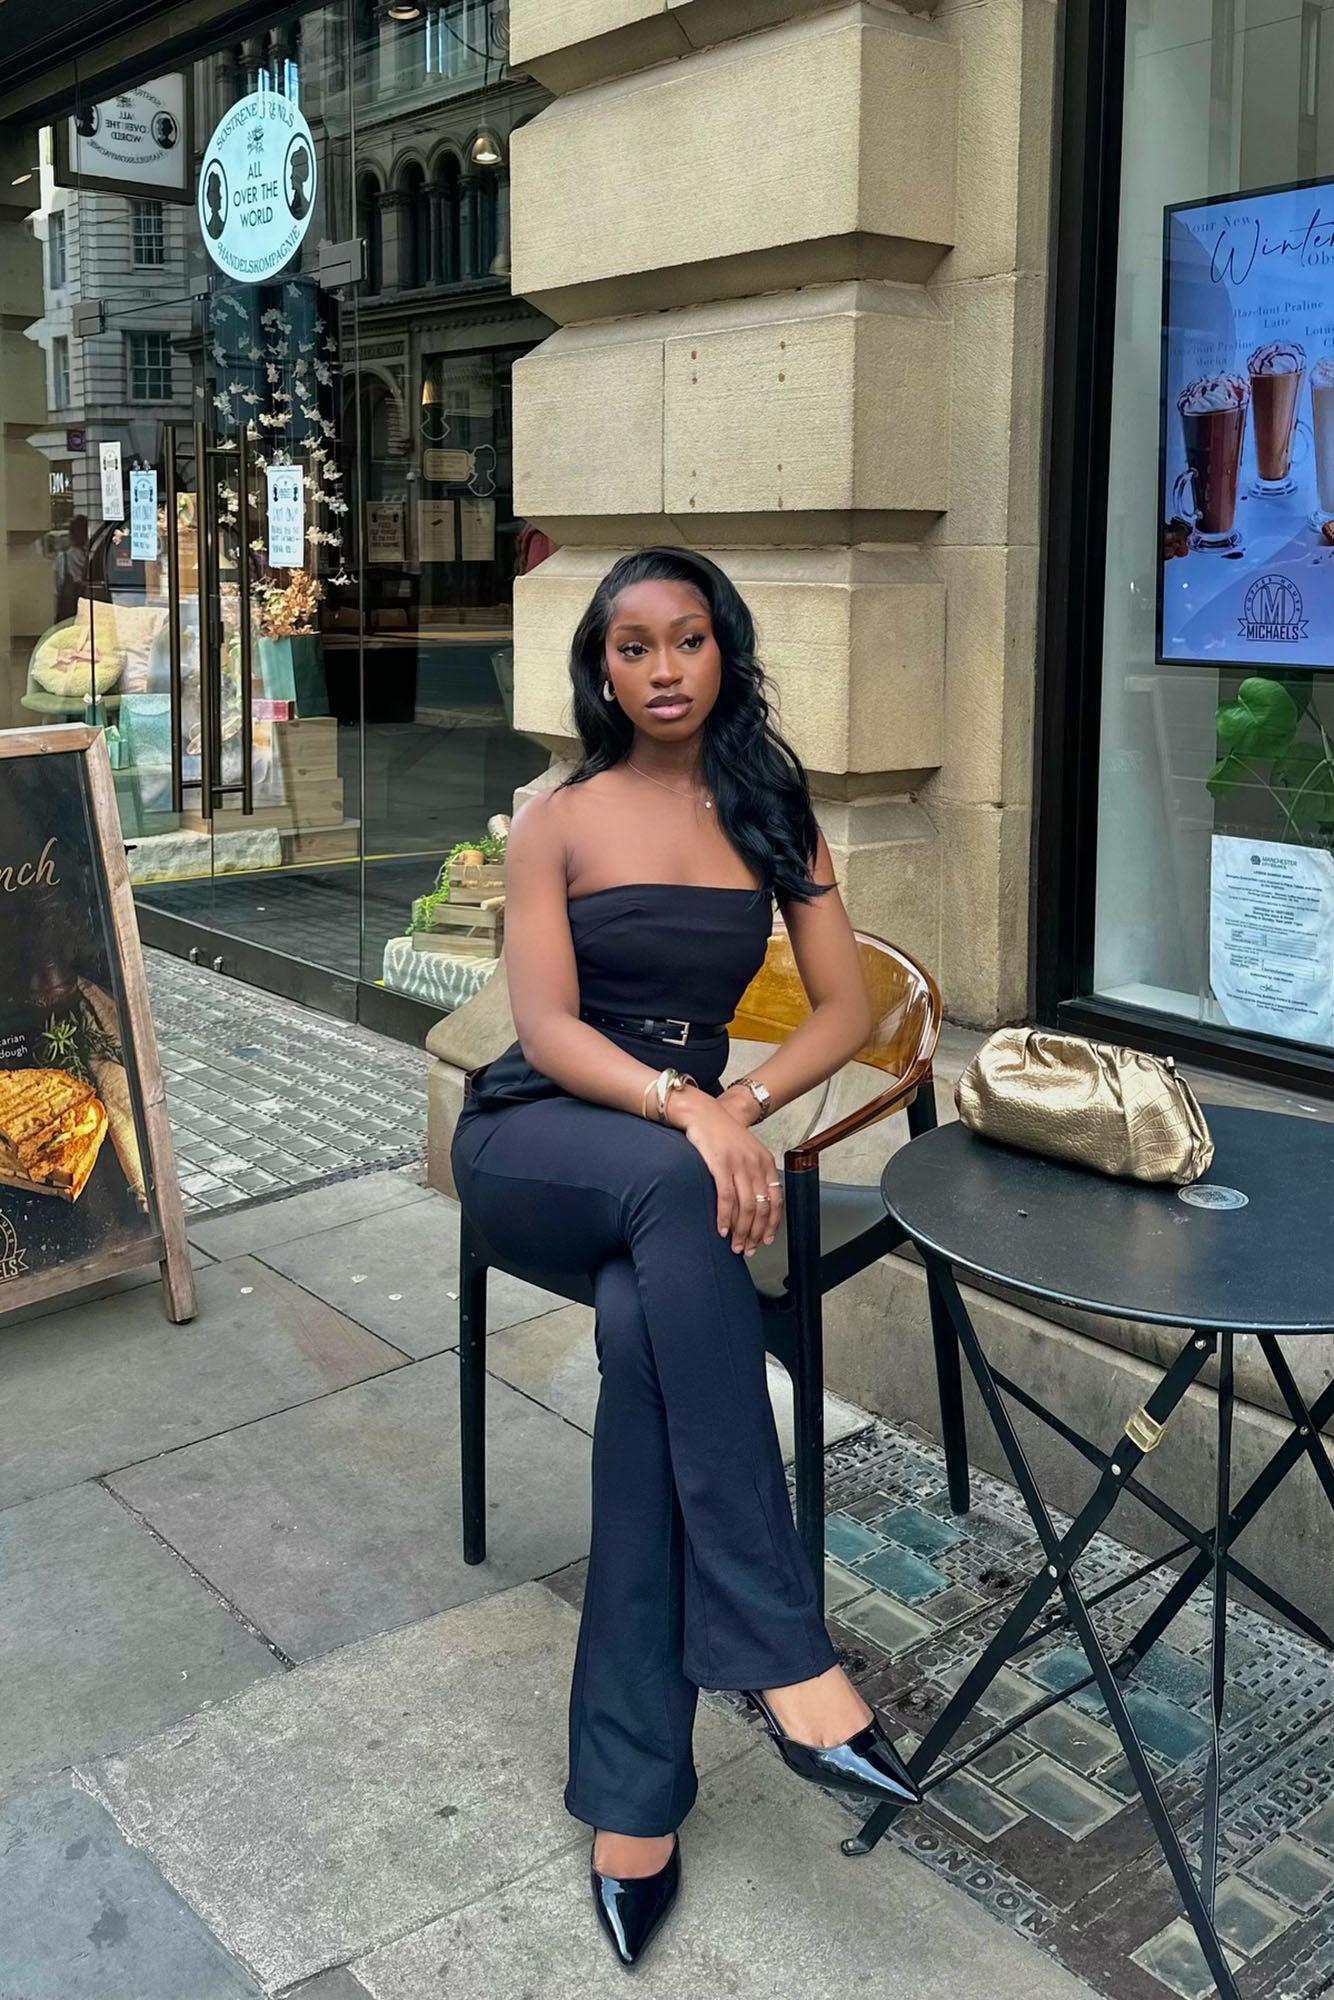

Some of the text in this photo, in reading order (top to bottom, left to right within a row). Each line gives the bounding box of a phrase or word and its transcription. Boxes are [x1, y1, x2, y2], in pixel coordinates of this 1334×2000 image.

[247, 161, 262, 180] ALL
[233, 180, 279, 207] OVER THE
[240, 206, 273, 228] WORLD
[1223, 215, 1251, 229] New
[1284, 299, 1324, 313] Praline
[1264, 318, 1291, 329] Latte
[1246, 624, 1300, 640] MICHAELS
